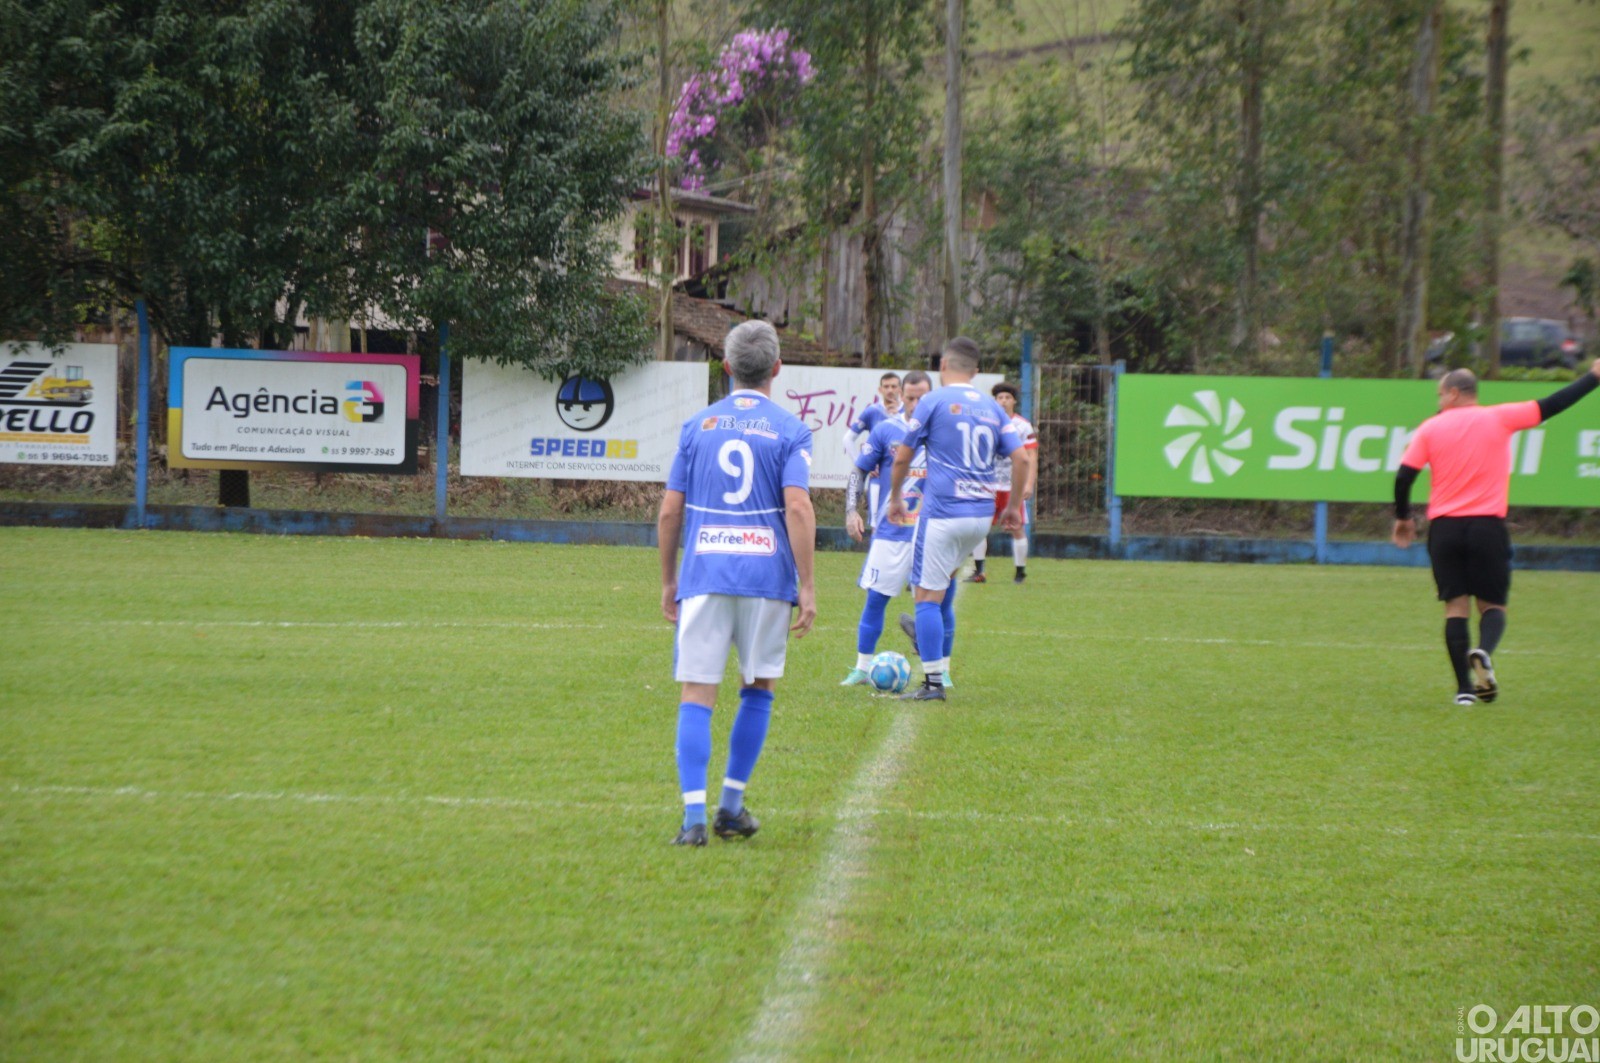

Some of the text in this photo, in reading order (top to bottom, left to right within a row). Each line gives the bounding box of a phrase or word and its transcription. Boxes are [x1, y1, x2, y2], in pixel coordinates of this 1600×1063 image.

[205, 386, 338, 418] Agência
[0, 408, 95, 434] ELLO
[237, 426, 351, 437] COMUNICAÇÃO VISUAL
[192, 442, 212, 451] Tudo
[230, 444, 258, 453] Placas
[267, 445, 306, 454] Adesivos
[341, 447, 348, 455] 9
[531, 438, 638, 459] SPEEDRS
[957, 422, 995, 470] 10
[1267, 406, 1545, 475] Sicri
[506, 461, 661, 472] INTERNET COM SERVIÇOS INOVADORES
[718, 439, 754, 505] 9
[700, 531, 771, 549] RefreeMaq
